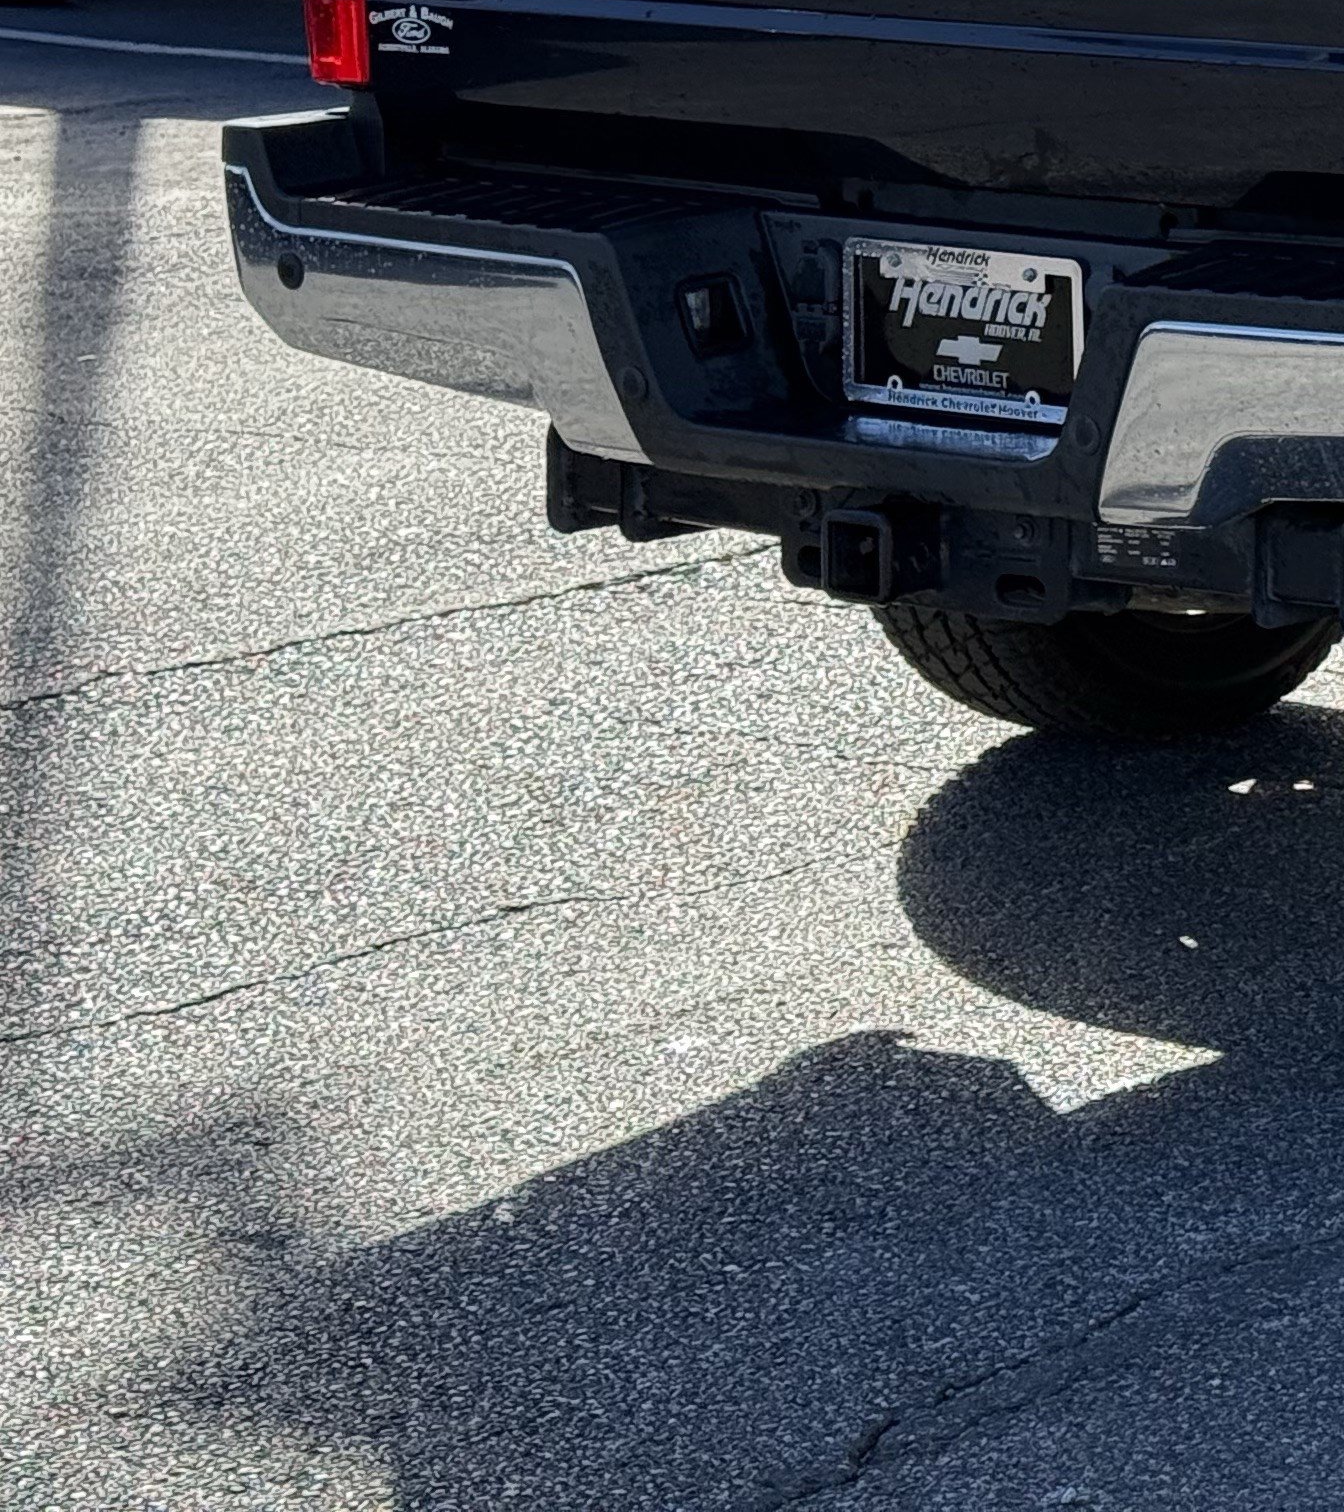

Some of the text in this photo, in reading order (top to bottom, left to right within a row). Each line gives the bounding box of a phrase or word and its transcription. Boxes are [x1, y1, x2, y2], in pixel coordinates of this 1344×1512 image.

[926, 246, 991, 267] Hendrick
[889, 276, 1052, 327] Hendrick
[933, 365, 1009, 388] CHEVROLET
